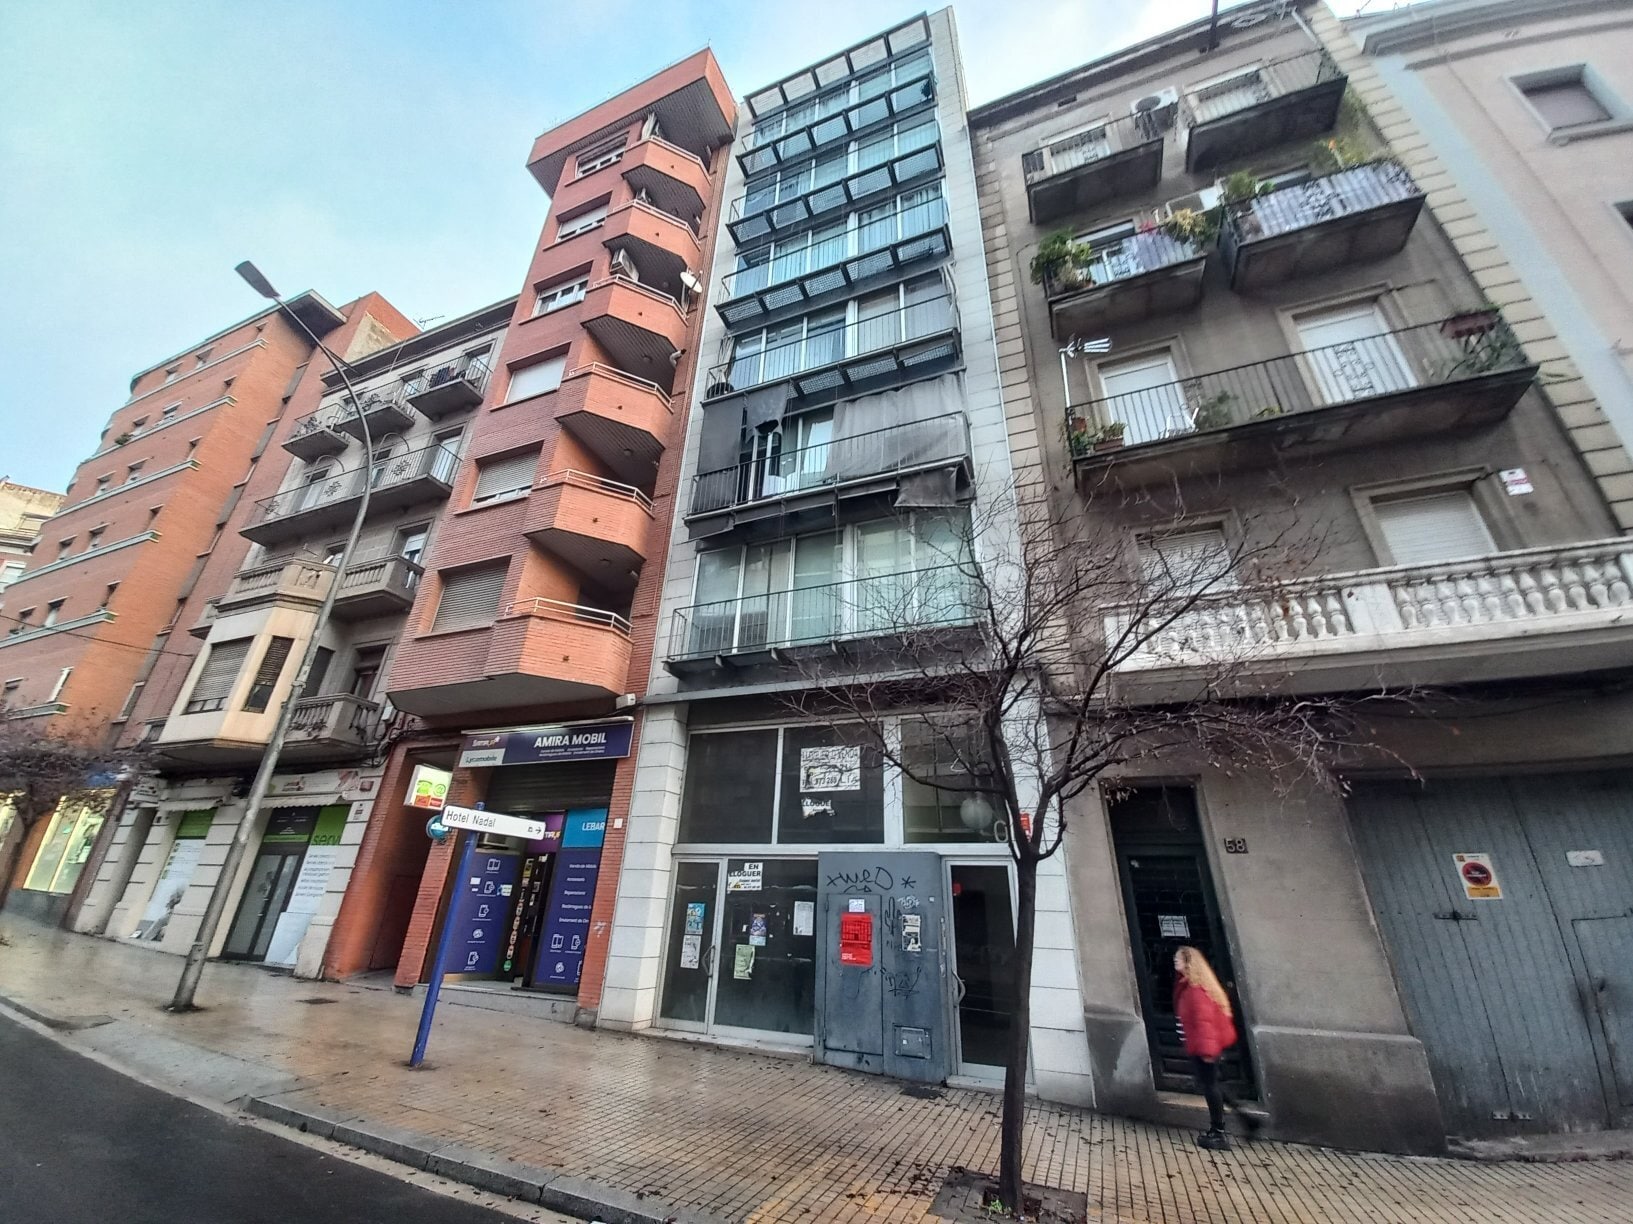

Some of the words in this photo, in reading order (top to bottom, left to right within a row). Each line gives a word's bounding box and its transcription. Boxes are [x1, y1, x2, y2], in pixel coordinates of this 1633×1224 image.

[534, 735, 570, 748] AMIRA
[572, 732, 607, 745] MOBIL
[446, 810, 470, 824] Hotel
[472, 815, 497, 829] Nadal
[1225, 839, 1245, 852] 58
